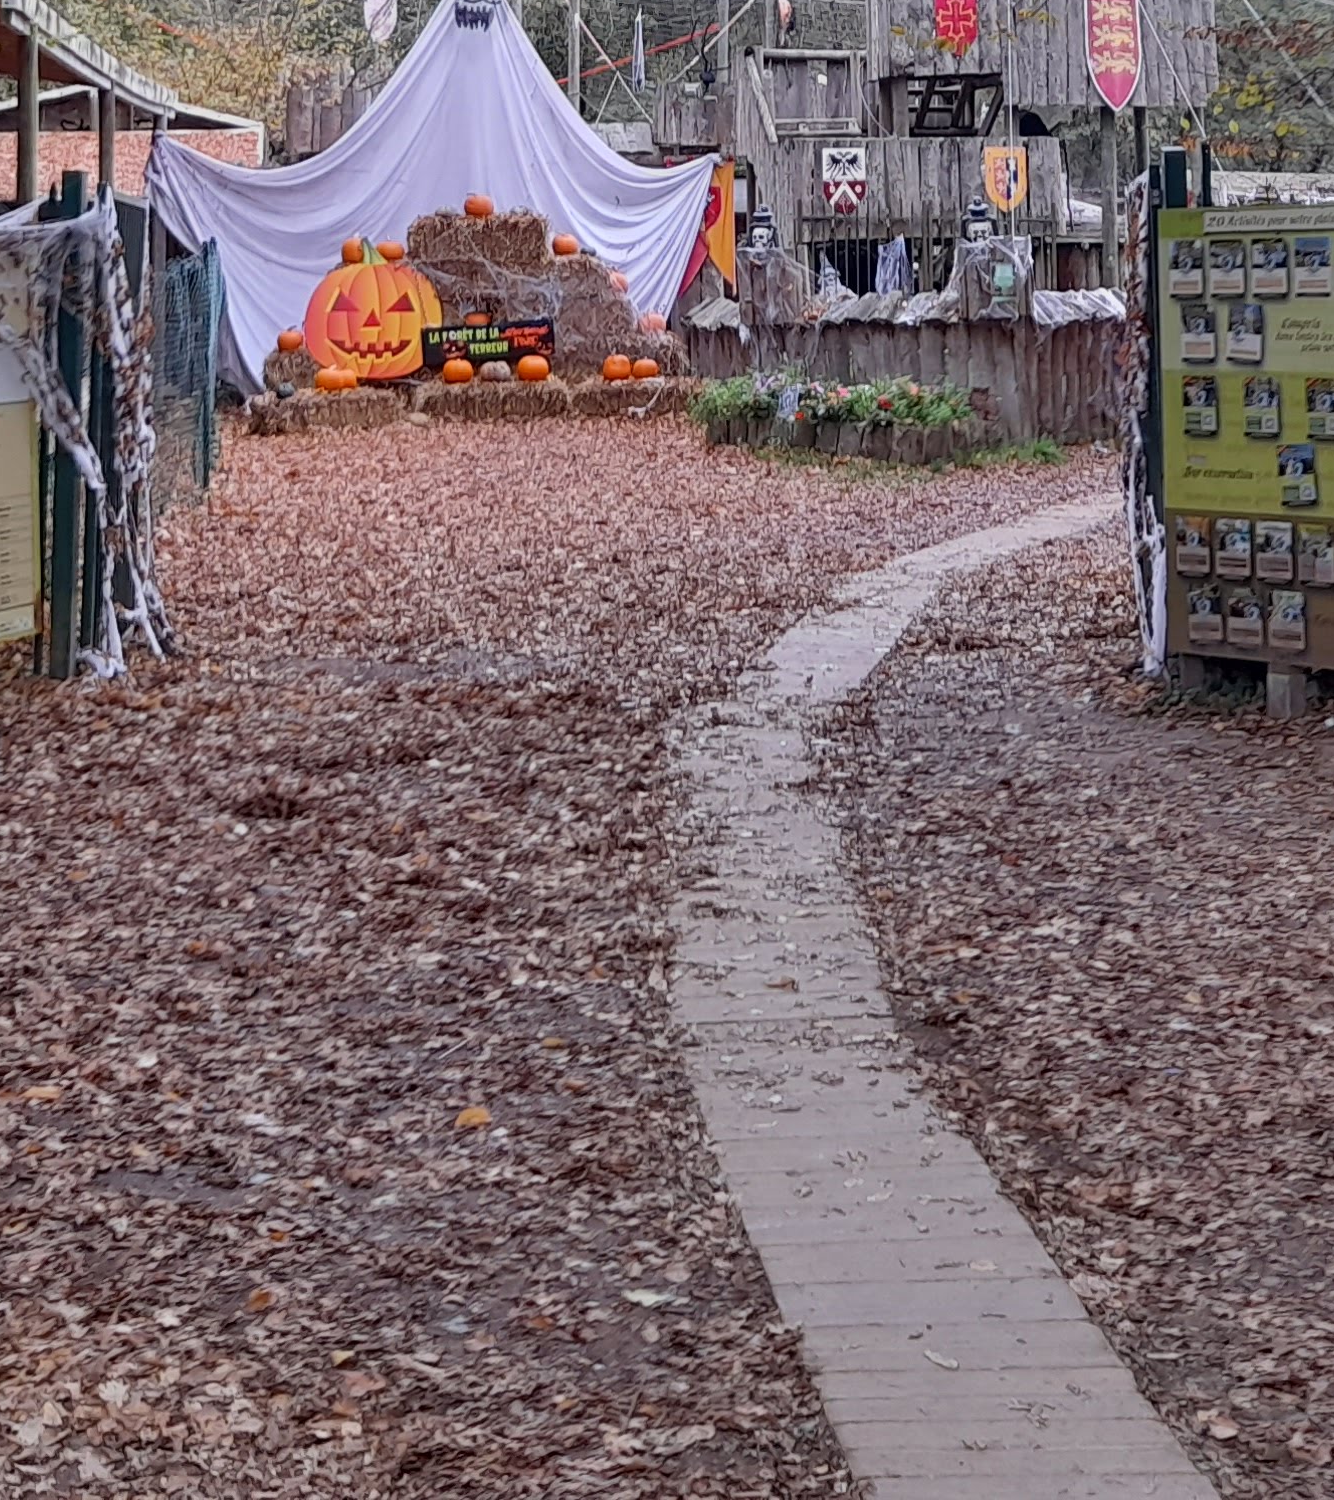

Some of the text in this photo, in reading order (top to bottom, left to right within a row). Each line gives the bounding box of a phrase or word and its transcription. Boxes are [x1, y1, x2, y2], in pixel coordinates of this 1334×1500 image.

[1207, 216, 1225, 227] 20
[1227, 214, 1266, 227] Activités
[1267, 216, 1287, 227] pour
[429, 331, 440, 344] LA
[475, 328, 487, 340] DE
[489, 327, 499, 339] LA
